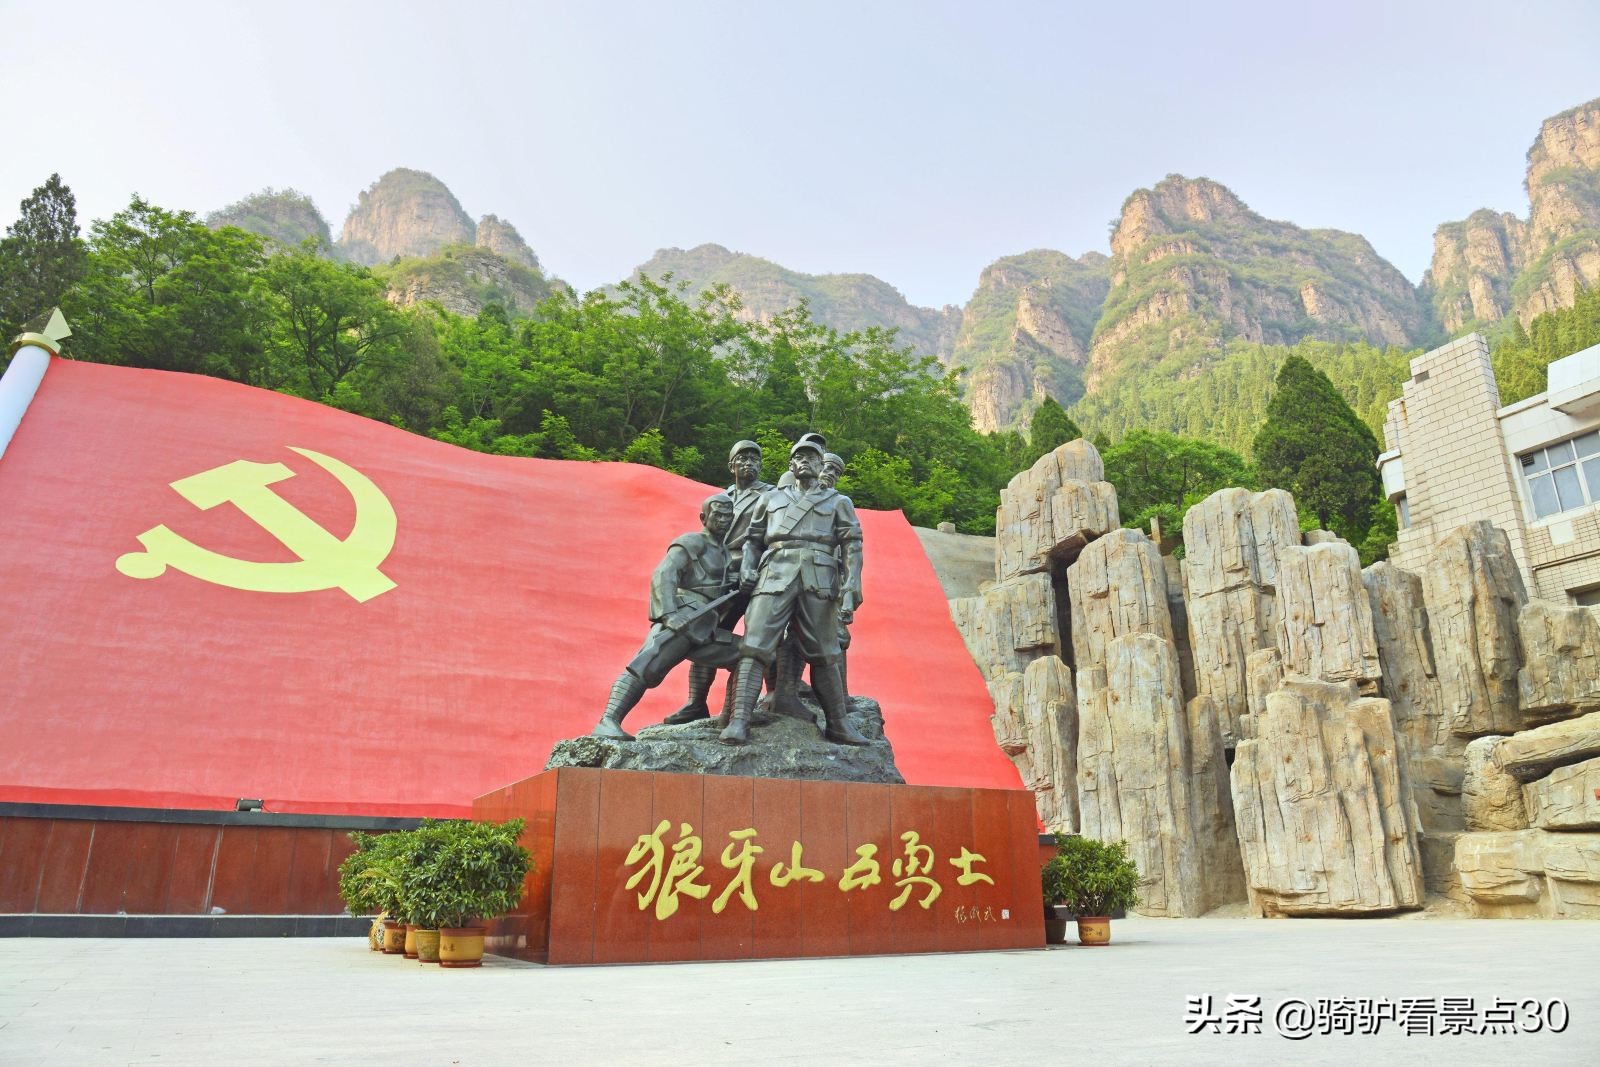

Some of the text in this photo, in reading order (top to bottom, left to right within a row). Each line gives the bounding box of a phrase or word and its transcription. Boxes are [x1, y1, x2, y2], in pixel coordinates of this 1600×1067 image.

[624, 819, 995, 921] 狼牙山五勇士
